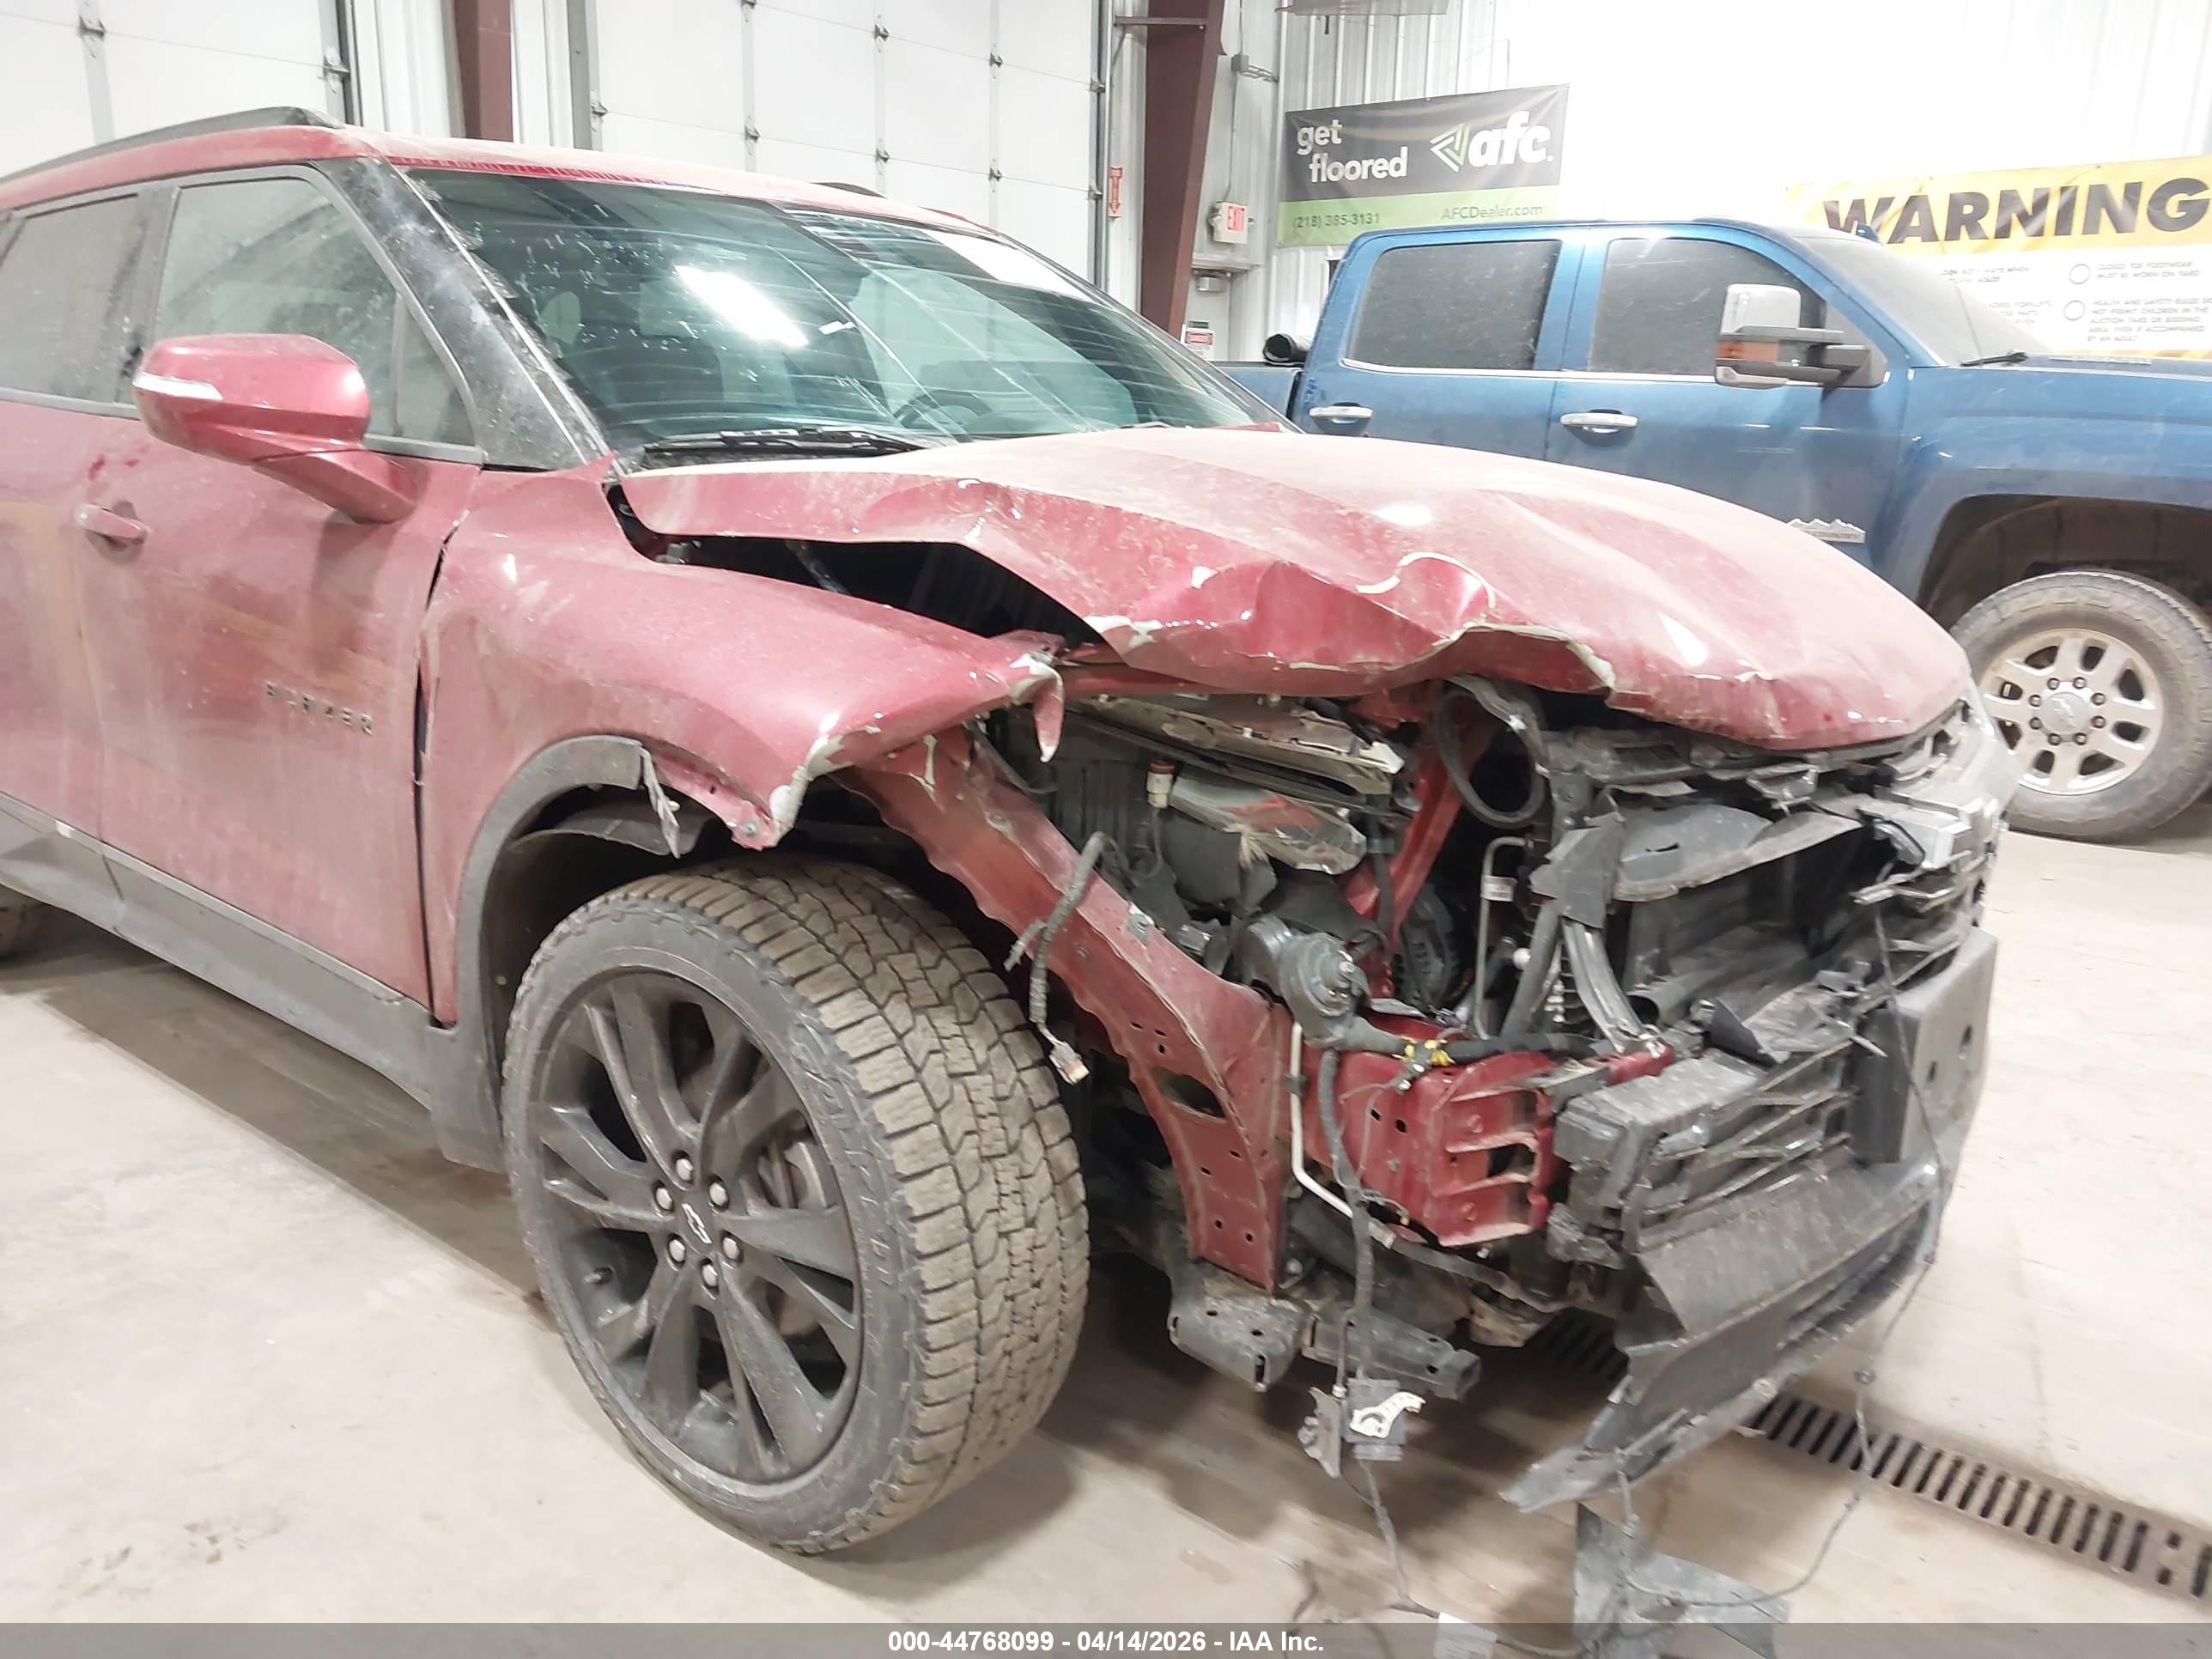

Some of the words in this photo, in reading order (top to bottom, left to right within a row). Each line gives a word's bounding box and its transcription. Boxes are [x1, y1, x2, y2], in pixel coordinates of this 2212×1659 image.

[1297, 119, 1343, 155] get
[1309, 146, 1408, 183] floored
[1292, 213, 1322, 230] (218)
[1324, 212, 1380, 228] 385-3131
[1441, 204, 1544, 221] AFCDealer.com
[1823, 177, 2212, 245] WARNING
